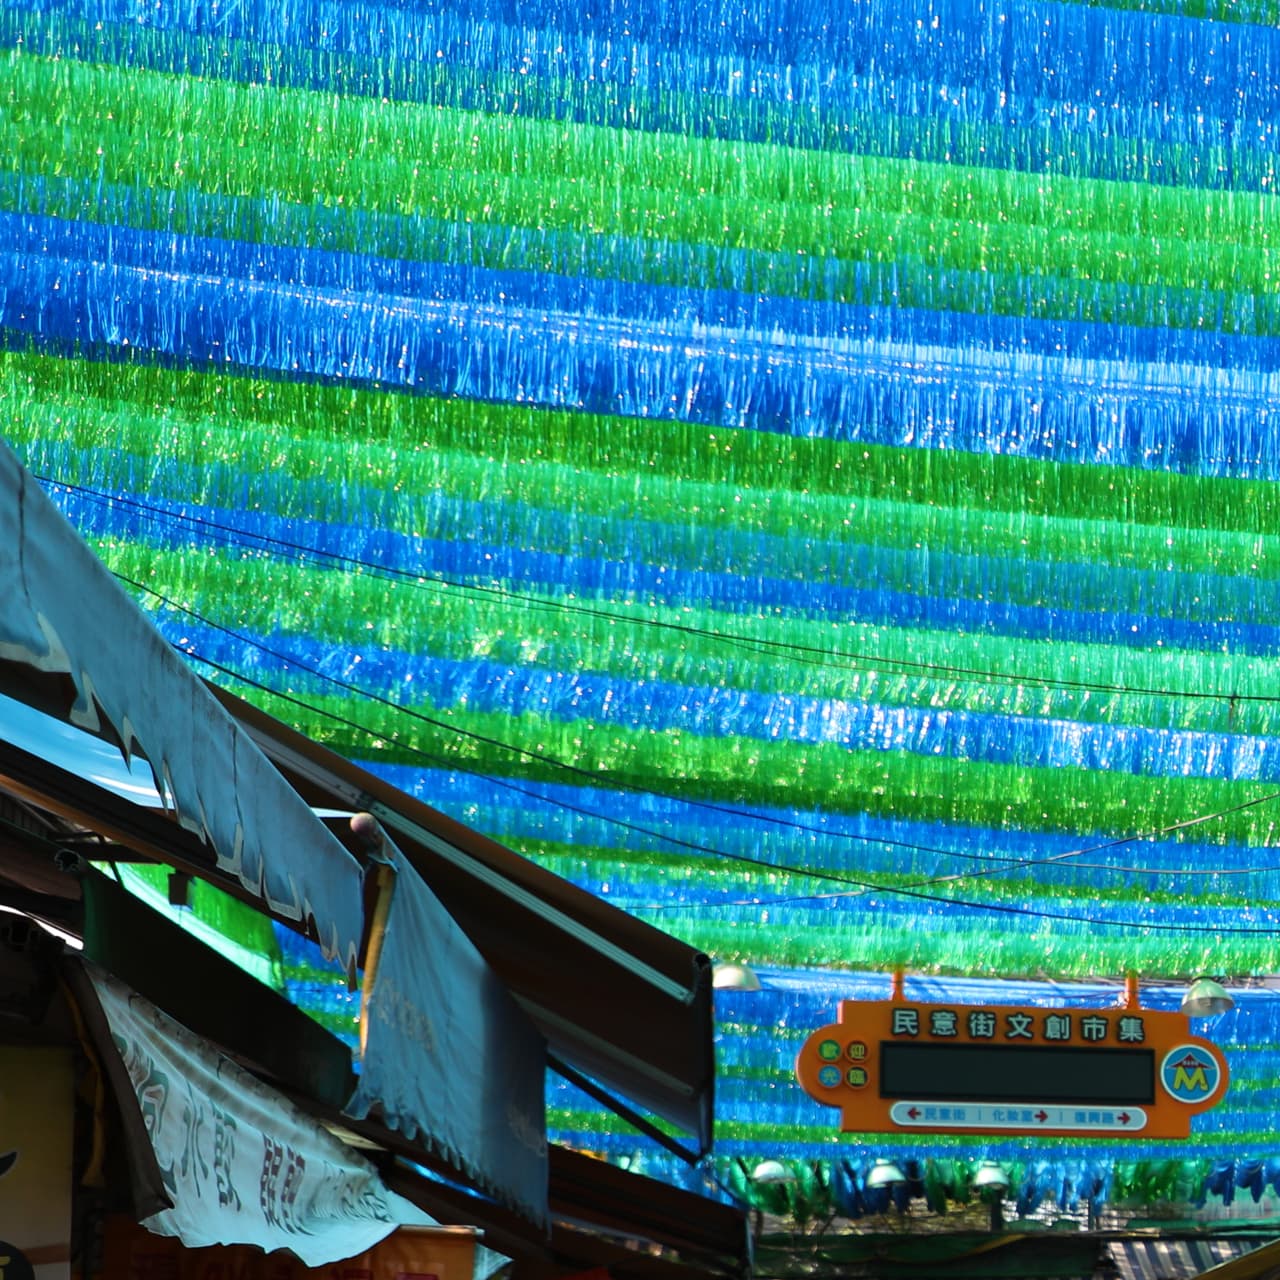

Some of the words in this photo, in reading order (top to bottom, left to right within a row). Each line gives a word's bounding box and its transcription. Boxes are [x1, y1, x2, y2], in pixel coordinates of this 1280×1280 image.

[892, 1009, 1146, 1043] 民意街文創市集
[924, 1107, 966, 1121] 民意街
